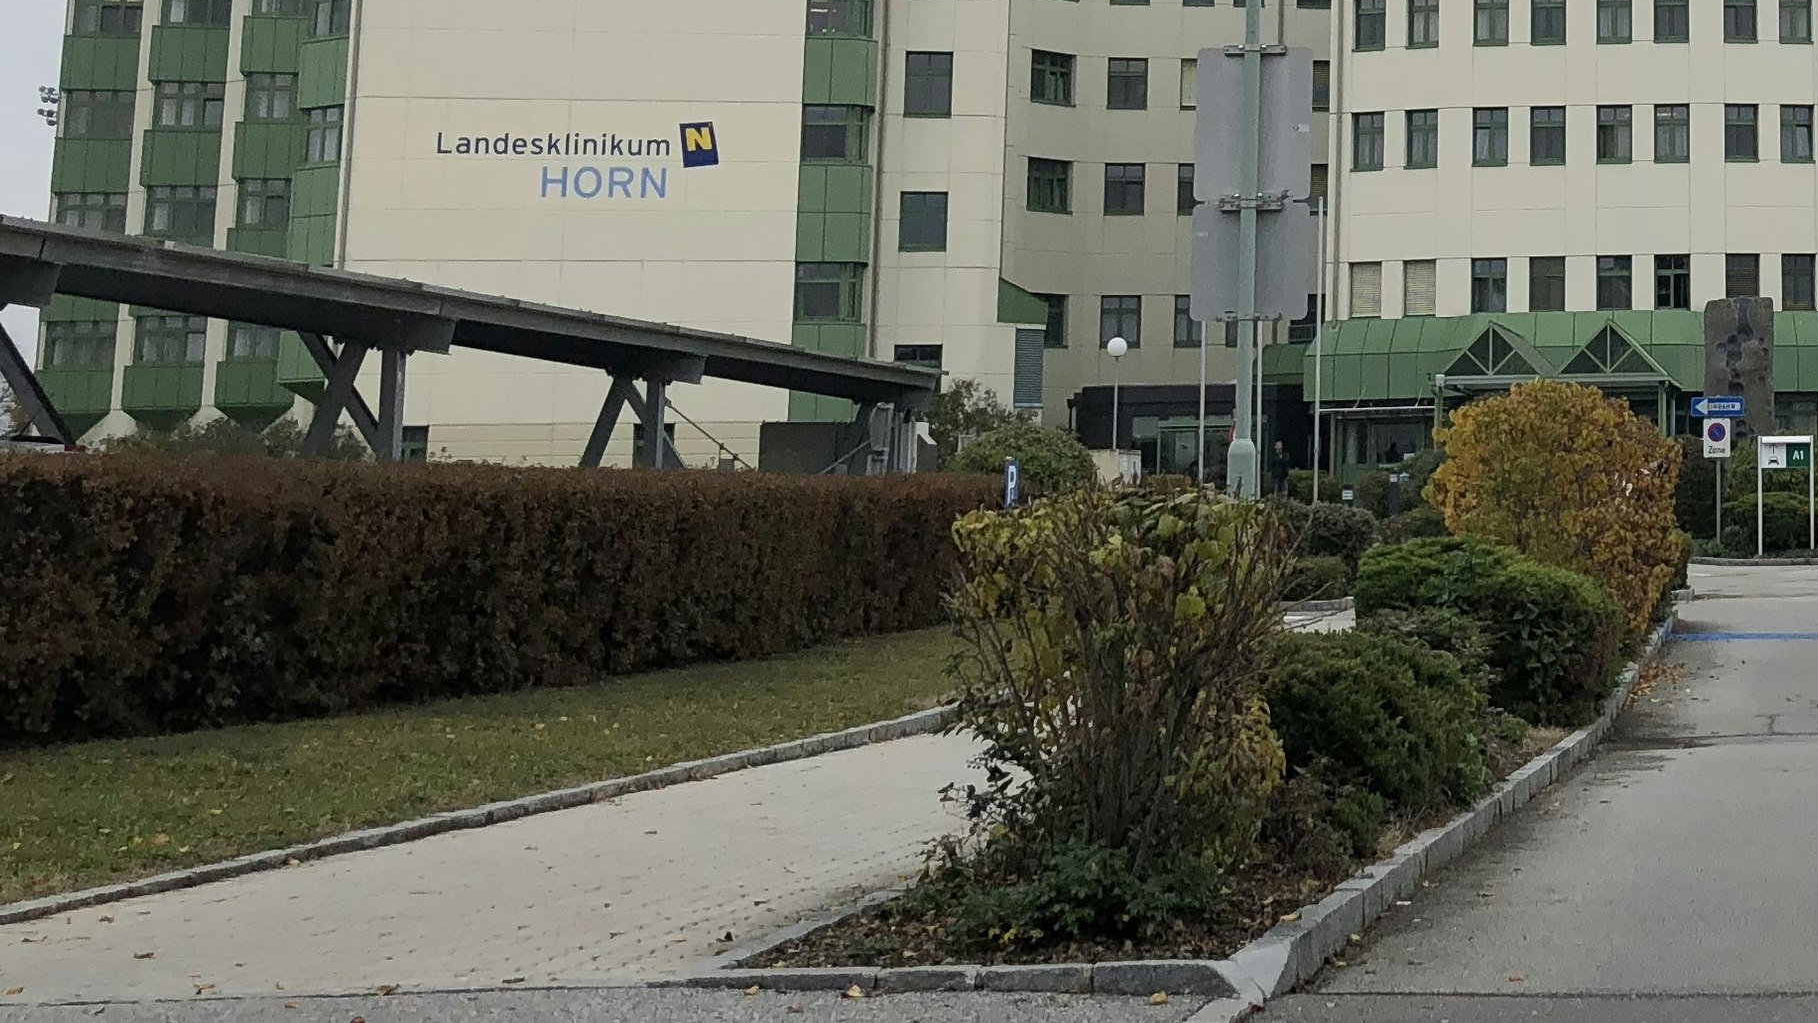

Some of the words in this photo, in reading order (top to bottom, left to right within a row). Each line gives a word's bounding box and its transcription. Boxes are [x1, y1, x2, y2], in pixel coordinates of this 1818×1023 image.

[437, 131, 670, 156] Landesklinikum
[540, 166, 667, 198] HORN
[1707, 445, 1727, 455] Zone
[1792, 450, 1804, 461] A1
[1006, 465, 1017, 506] P
